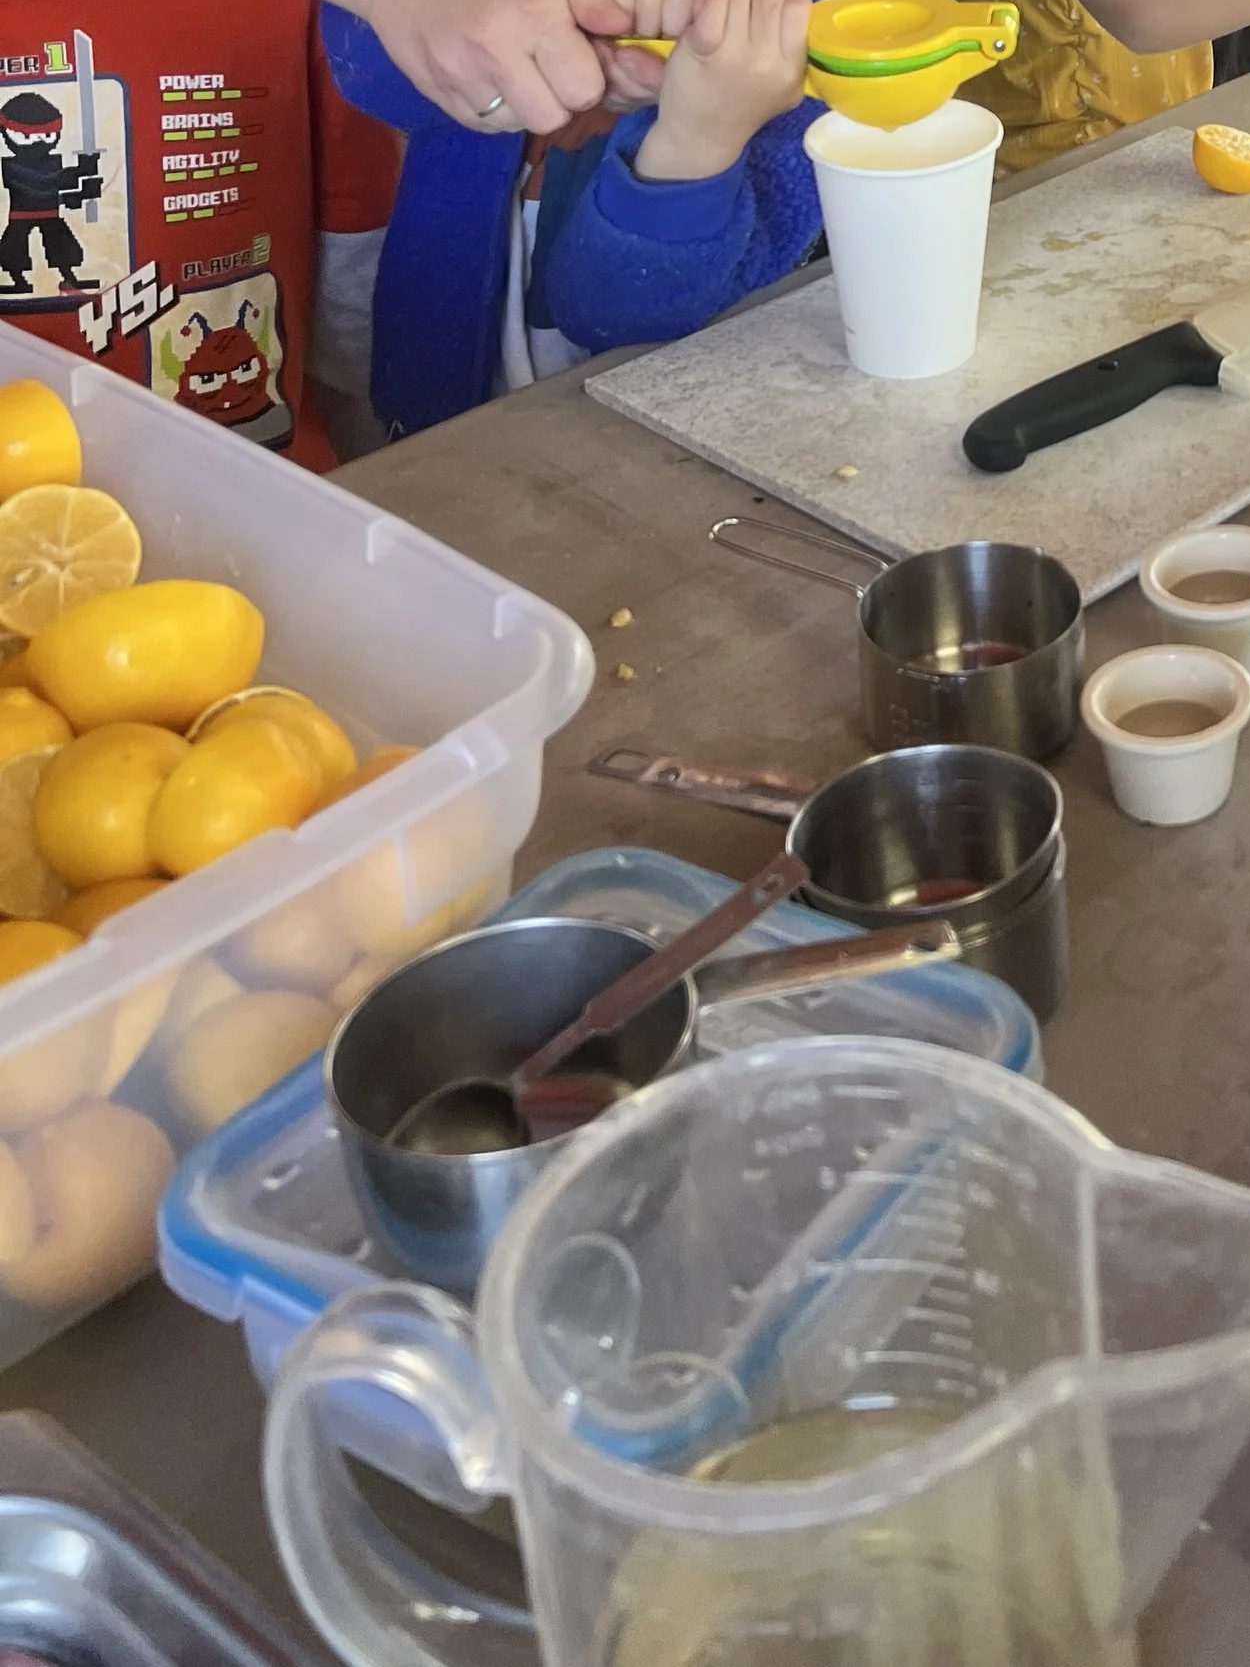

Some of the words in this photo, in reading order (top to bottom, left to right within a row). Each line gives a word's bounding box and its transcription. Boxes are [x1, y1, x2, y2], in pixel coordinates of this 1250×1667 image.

[0, 55, 39, 74] ER
[44, 41, 73, 75] 1
[159, 74, 225, 91] POWER
[161, 112, 234, 130] BRAINS
[162, 149, 240, 170] AGILITY
[164, 187, 239, 212] GADGETS
[182, 248, 251, 282] PLAYER
[79, 260, 178, 356] VS.
